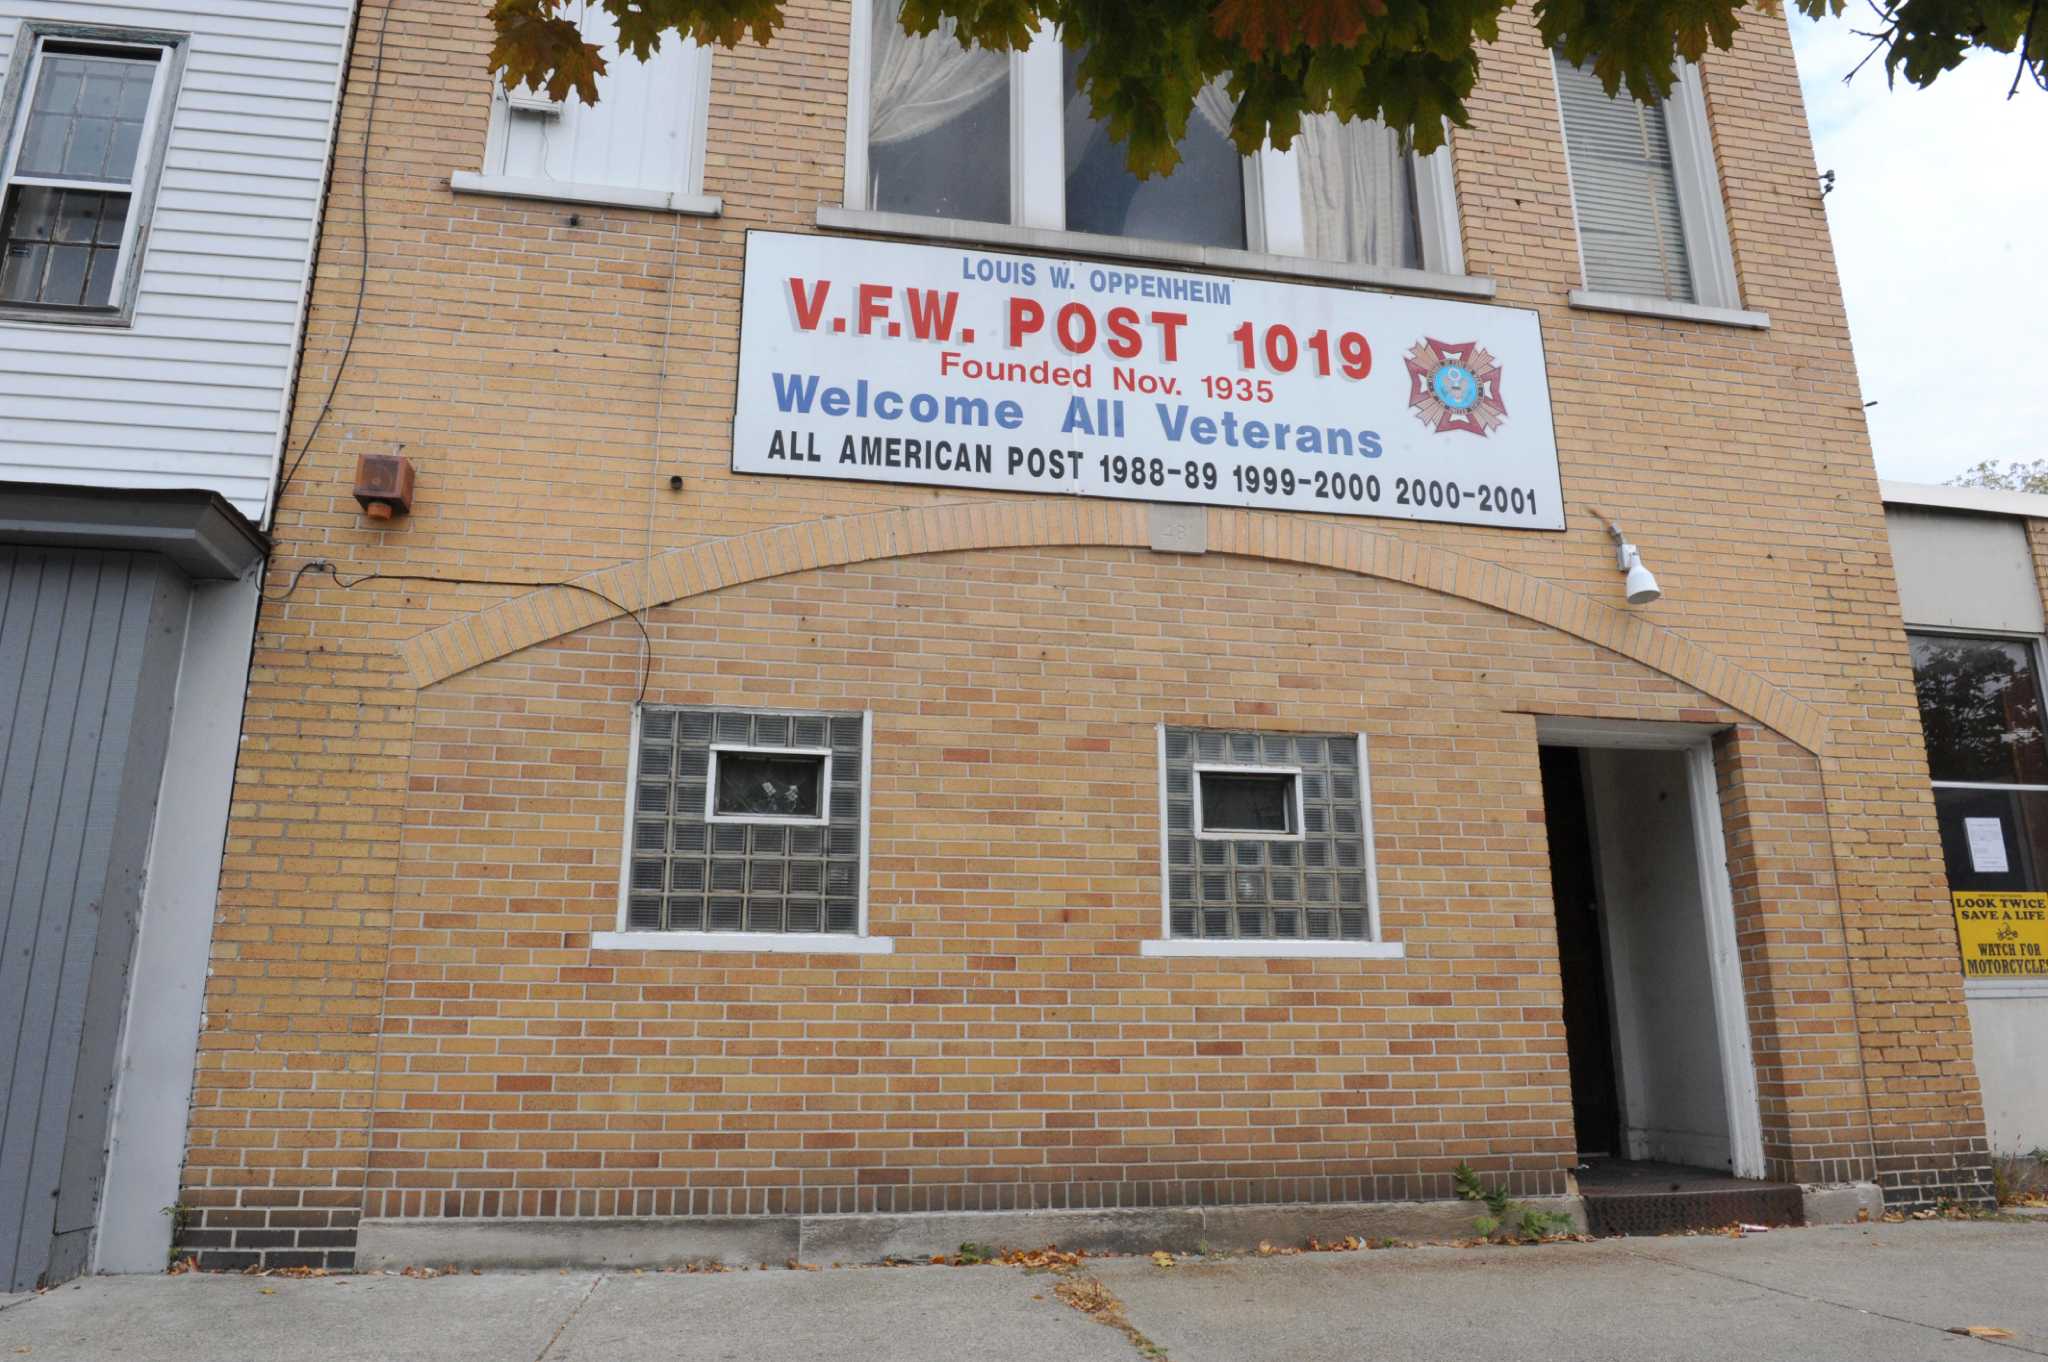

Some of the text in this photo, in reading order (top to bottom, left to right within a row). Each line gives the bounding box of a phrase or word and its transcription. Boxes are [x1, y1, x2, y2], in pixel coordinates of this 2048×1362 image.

[963, 257, 1231, 305] LOUIS W. OPPENHEIM
[789, 277, 1372, 380] V.F.W. POST 1019
[940, 352, 1274, 403] Founded Nov. 1935
[772, 373, 1383, 458] Welcome All Veterans
[768, 430, 1537, 515] ALL AMERICAN POST 1988-89 1999-2000 2000-2001
[1956, 899, 2046, 908] LOOK TWICE
[1962, 911, 2045, 920] SAVE A LIFE
[1978, 944, 2041, 956] WATCH FOR
